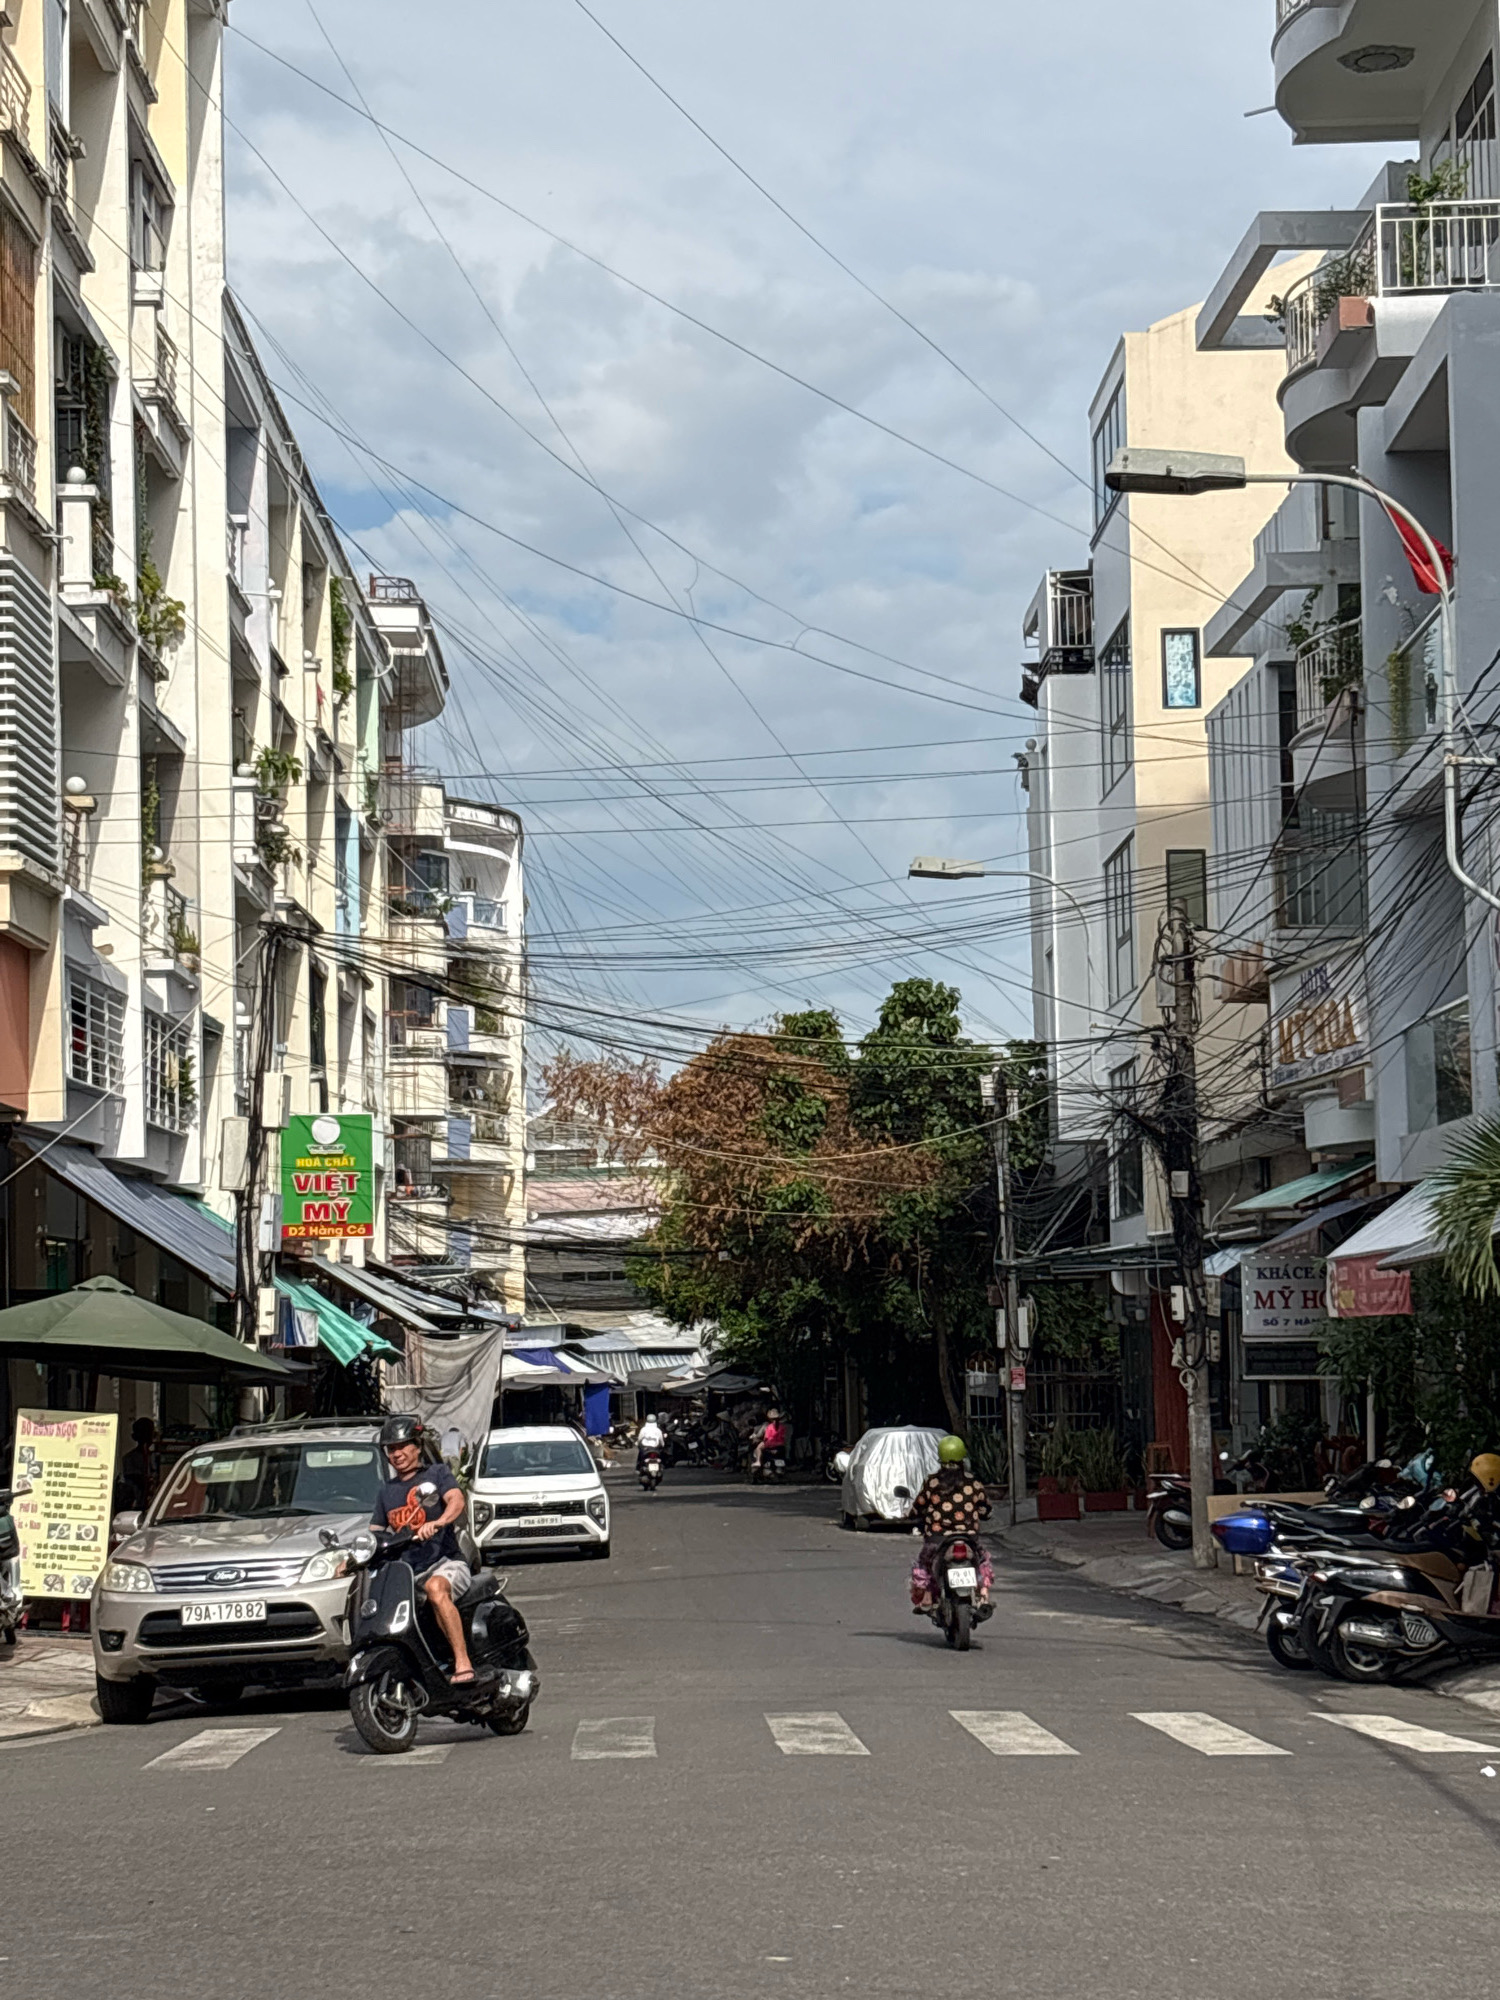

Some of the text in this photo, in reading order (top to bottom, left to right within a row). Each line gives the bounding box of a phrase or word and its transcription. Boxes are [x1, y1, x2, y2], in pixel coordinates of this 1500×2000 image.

[292, 1168, 360, 1197] VIỆT
[302, 1197, 352, 1222] MỸ
[288, 1226, 306, 1236] D2
[309, 1225, 343, 1238] Hàng
[1253, 1285, 1295, 1310] MỸ
[1262, 1316, 1279, 1327] SỐ
[1283, 1318, 1290, 1326] 7
[213, 1570, 238, 1581] Ford
